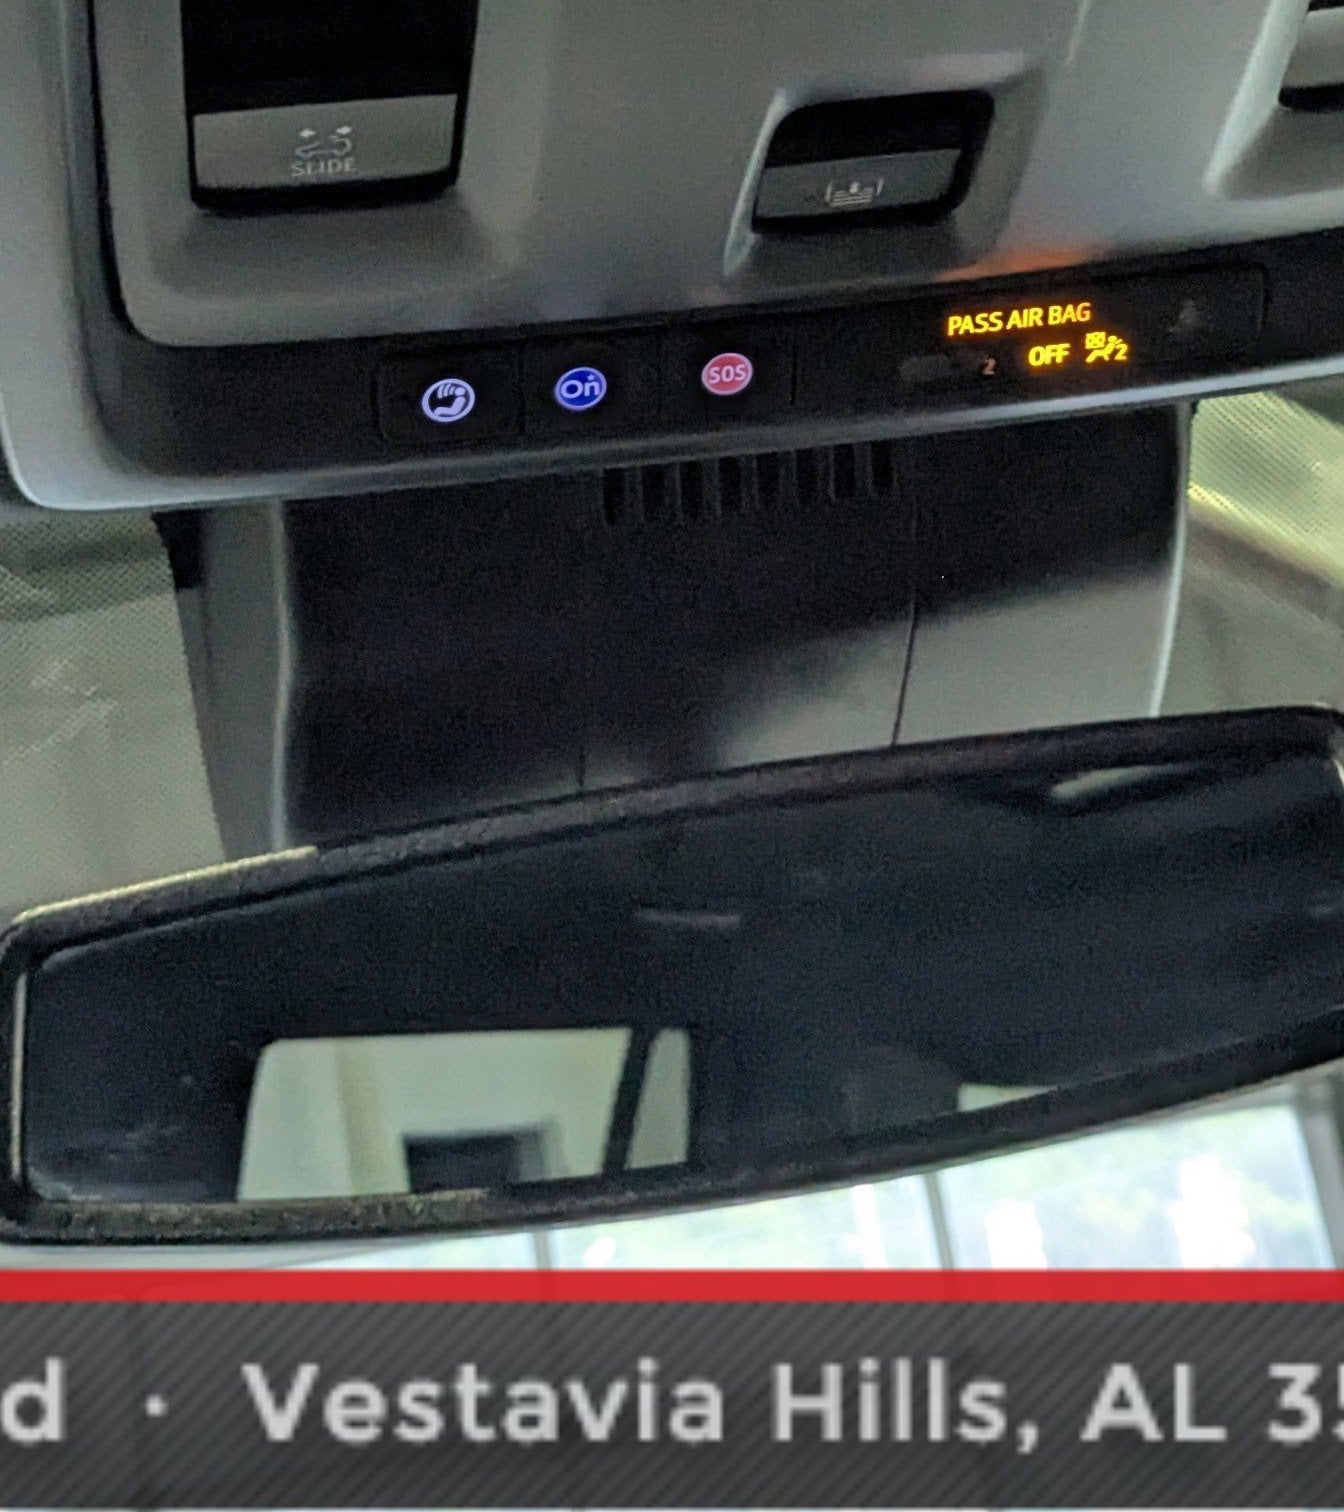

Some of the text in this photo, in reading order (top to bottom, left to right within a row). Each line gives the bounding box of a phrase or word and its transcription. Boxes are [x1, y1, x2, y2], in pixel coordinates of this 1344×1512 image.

[290, 157, 354, 177] SLIDE
[947, 302, 1091, 336] PASS AIR BAG
[1028, 343, 1071, 366] OFF
[708, 364, 748, 385] SOS
